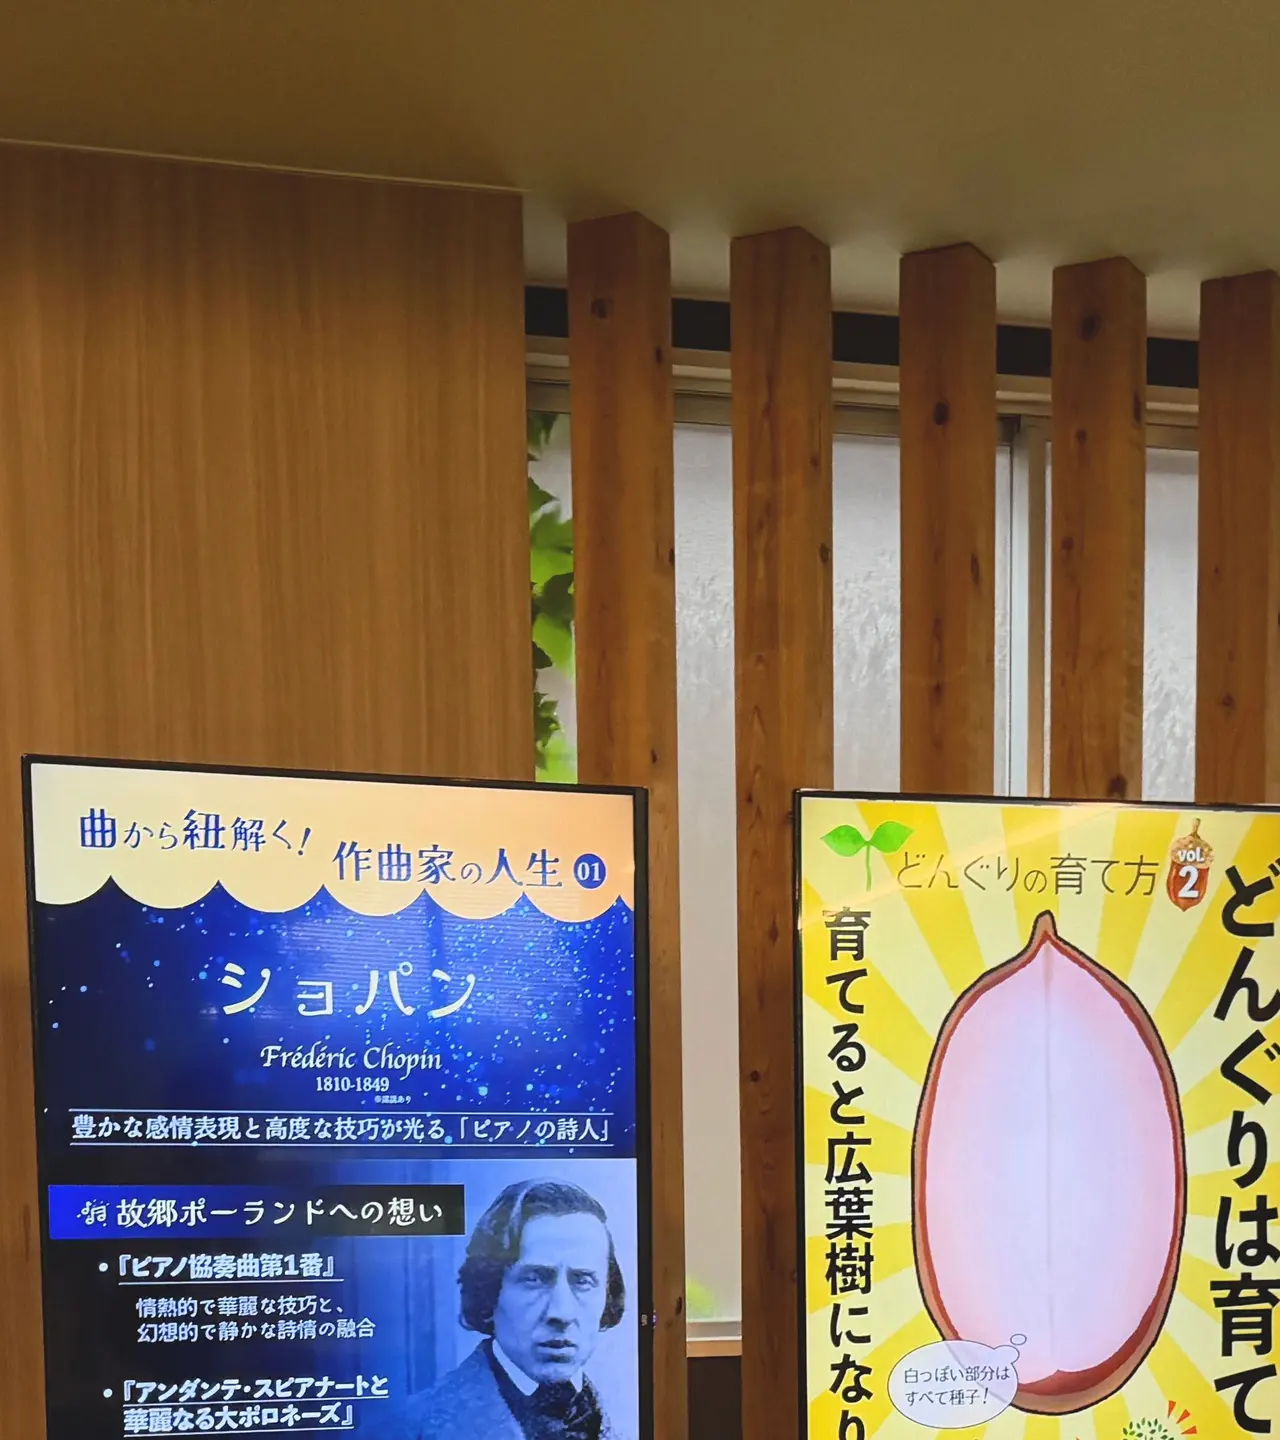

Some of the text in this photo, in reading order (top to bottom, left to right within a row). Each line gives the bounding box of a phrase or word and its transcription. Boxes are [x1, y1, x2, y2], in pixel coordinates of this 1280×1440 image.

[332, 840, 563, 888] 作曲家の人生
[575, 859, 602, 884] 01
[896, 852, 1160, 896] どんぐりの育て方
[1177, 865, 1199, 898] 2
[221, 961, 476, 1018] ショパン
[261, 1042, 442, 1081] Frédéric Chopin
[316, 1076, 390, 1093] 1810-1849
[72, 1114, 612, 1143] 豊かな感情表現と高度な技巧が光る「ピアノの詩人」
[116, 1197, 443, 1229] 故郷ポーランドへの想い
[118, 1253, 335, 1279] 『ピアノ協奏曲第1番』
[136, 1295, 344, 1319] 情熱的で華麗な技巧と、
[137, 1319, 376, 1343] 幻想的で静かな詩情の融合
[123, 1375, 389, 1403] 『アンダンテ・スピアナートと
[903, 1365, 1011, 1384] 白っぽい部分は
[905, 1387, 989, 1406] すべて種子！
[124, 1401, 354, 1432] 華麗なる大ポロネーズ』
